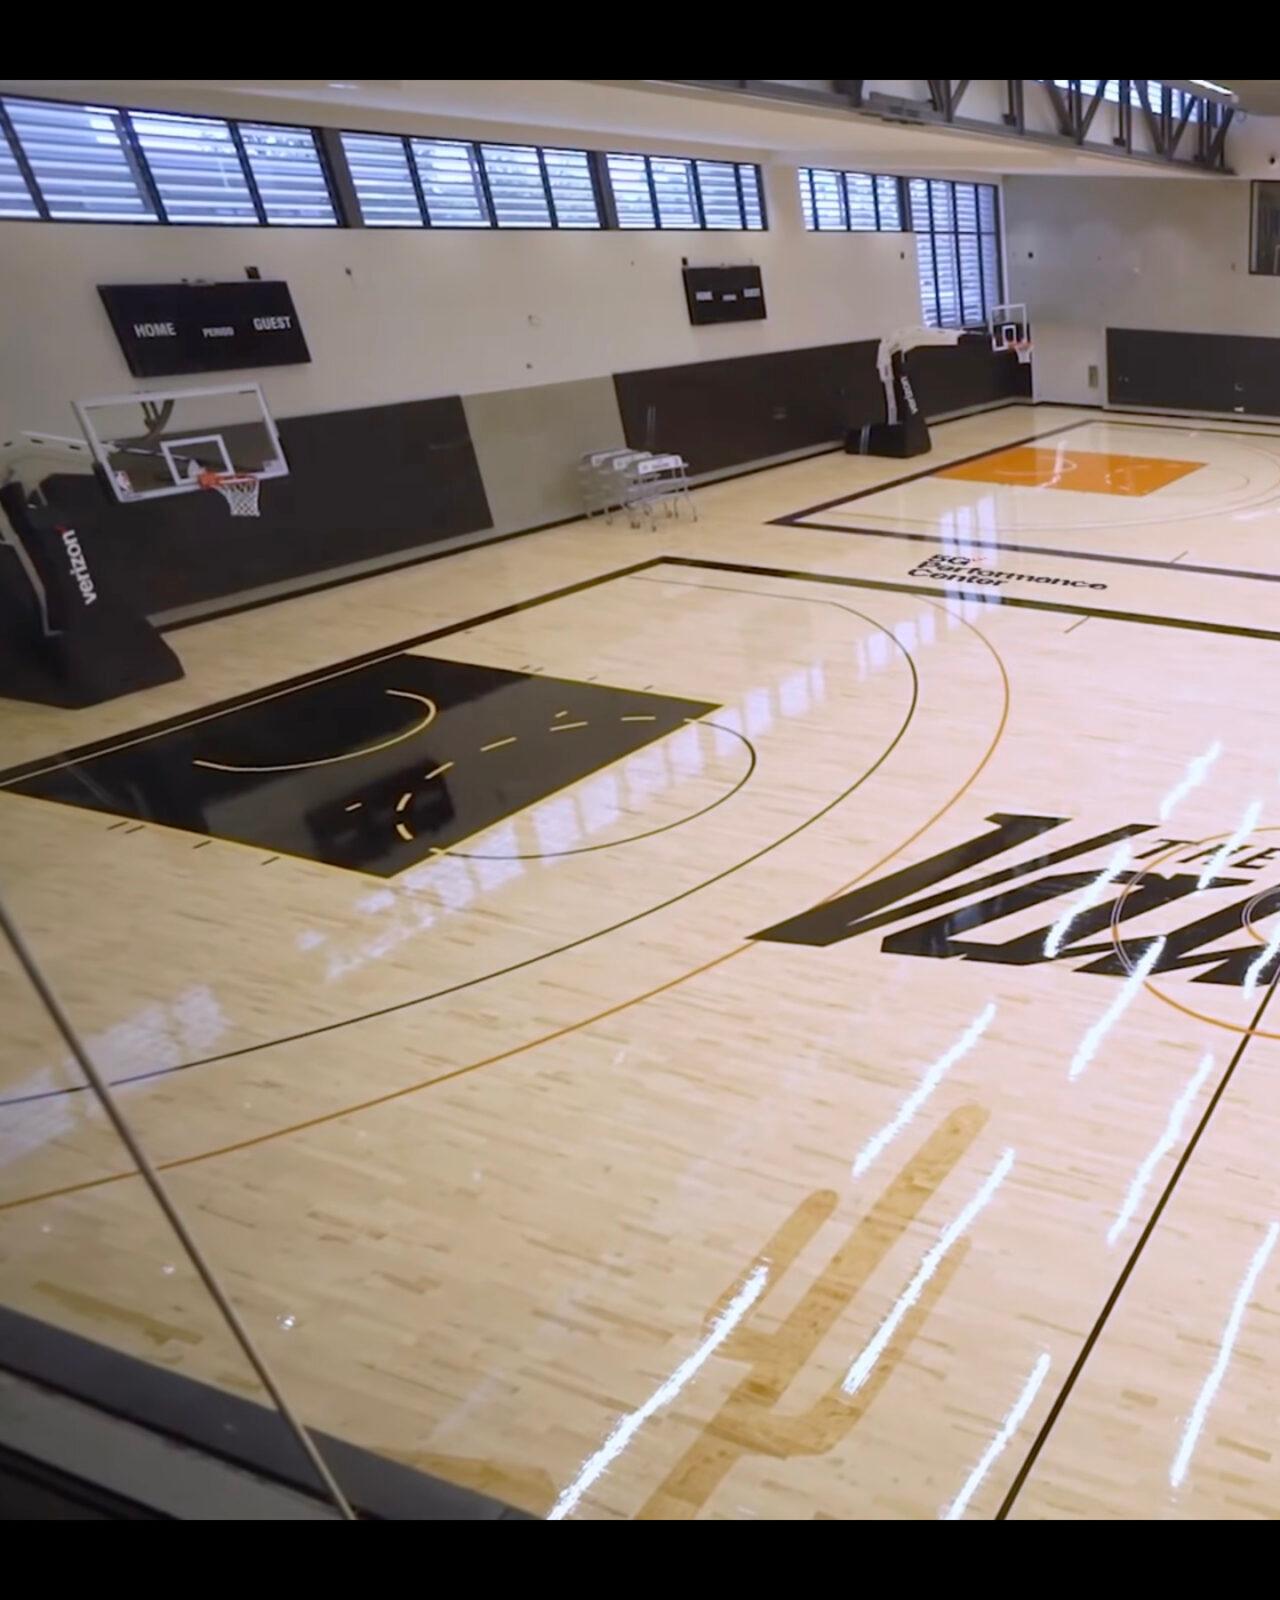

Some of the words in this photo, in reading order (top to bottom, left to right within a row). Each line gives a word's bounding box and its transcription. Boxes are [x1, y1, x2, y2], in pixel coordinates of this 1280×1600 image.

[133, 322, 177, 338] HOME
[202, 326, 235, 338] PERIOD
[253, 316, 292, 331] GUEST
[62, 529, 98, 606] verizon
[908, 568, 1010, 587] Center
[917, 560, 1108, 591] Performance
